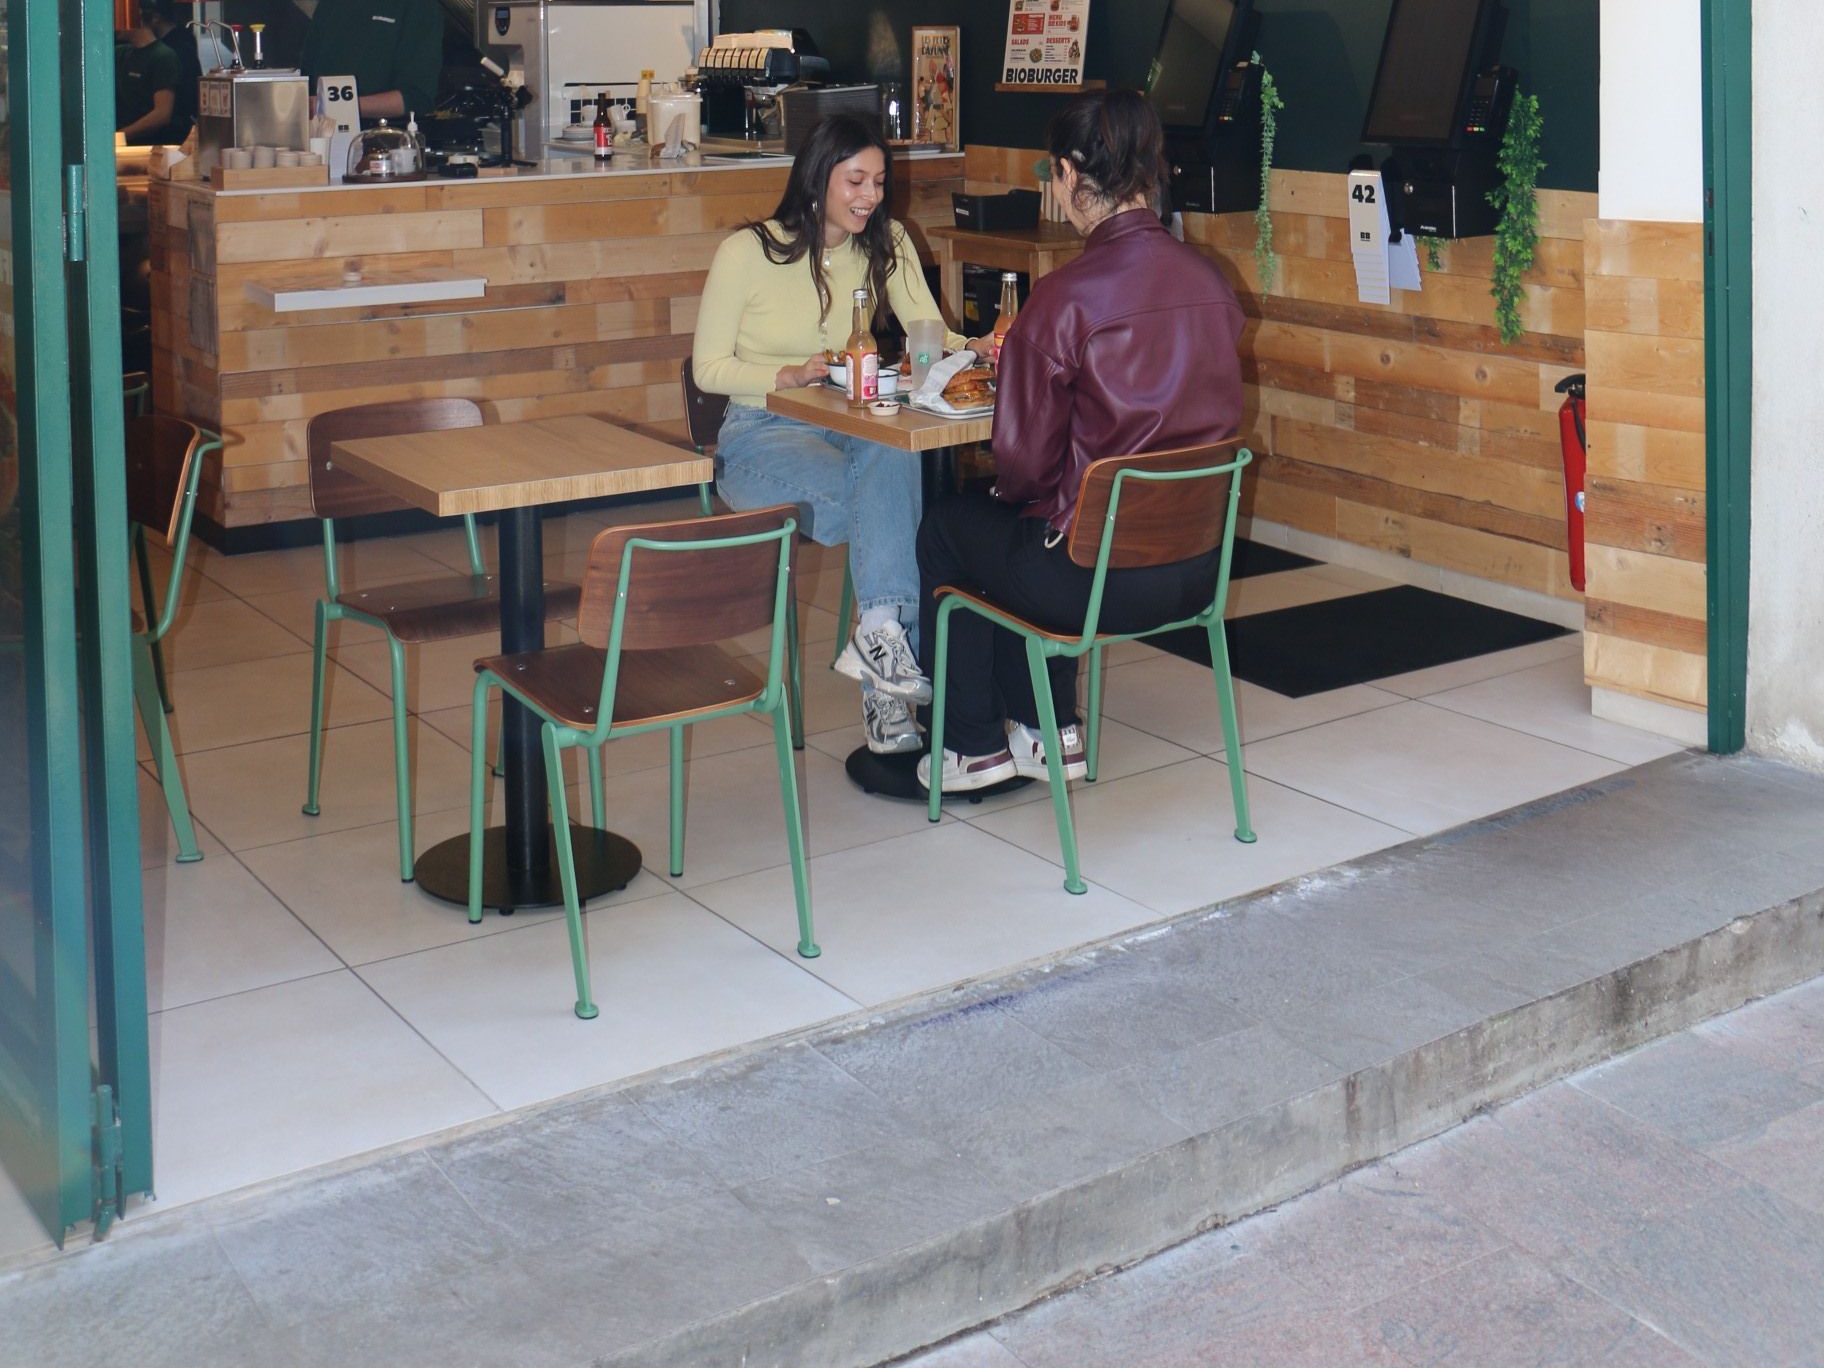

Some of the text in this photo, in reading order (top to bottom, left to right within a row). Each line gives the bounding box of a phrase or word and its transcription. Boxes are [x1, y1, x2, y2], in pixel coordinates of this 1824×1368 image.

[1005, 67, 1079, 84] BIOBURGER
[327, 85, 354, 102] 36
[1352, 184, 1376, 203] 42
